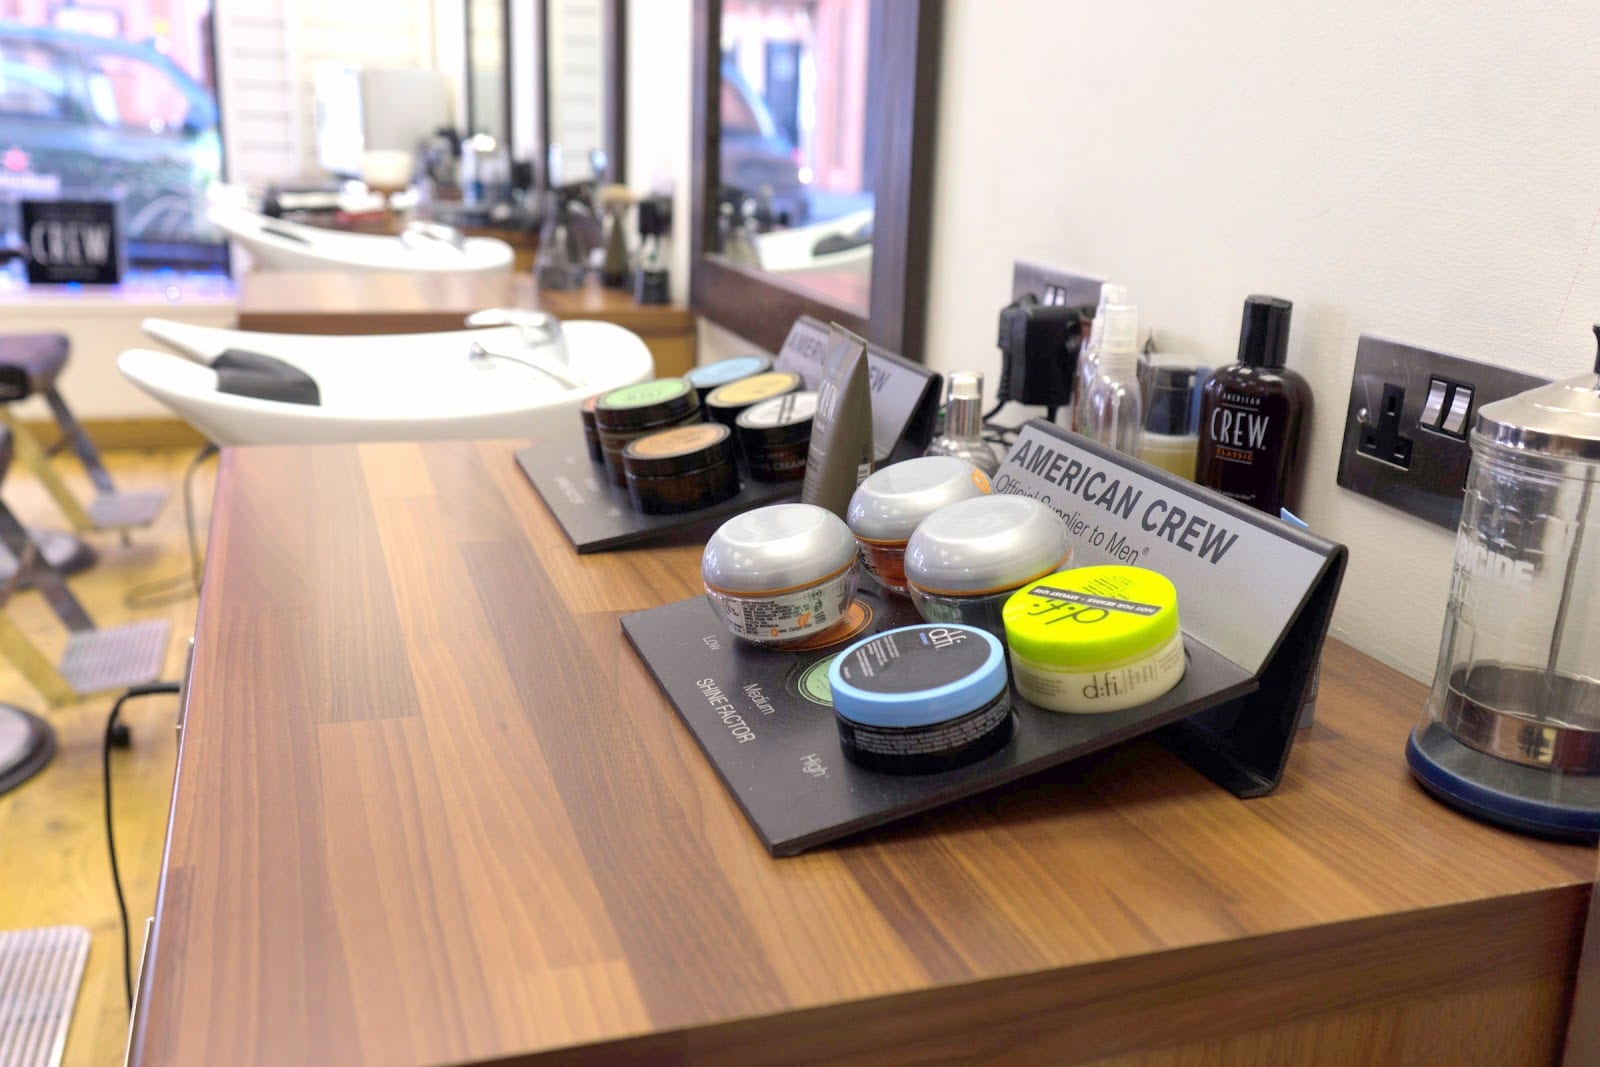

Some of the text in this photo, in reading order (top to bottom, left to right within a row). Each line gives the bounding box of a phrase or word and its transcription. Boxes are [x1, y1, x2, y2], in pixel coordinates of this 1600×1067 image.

[30, 220, 111, 266] CREW
[1222, 393, 1261, 405] AMERICAN
[1216, 448, 1254, 461] CLASSIC
[1010, 439, 1240, 565] AMERICAN CREW
[1041, 495, 1090, 538] Splier
[1088, 525, 1105, 546] to
[1087, 597, 1116, 608] RESALE
[1116, 602, 1135, 610] FOR
[1135, 605, 1158, 614] NOT
[702, 633, 722, 651] Low
[742, 683, 775, 716] Medium
[696, 677, 756, 744] SHINE FACTOR
[800, 753, 828, 778] High
